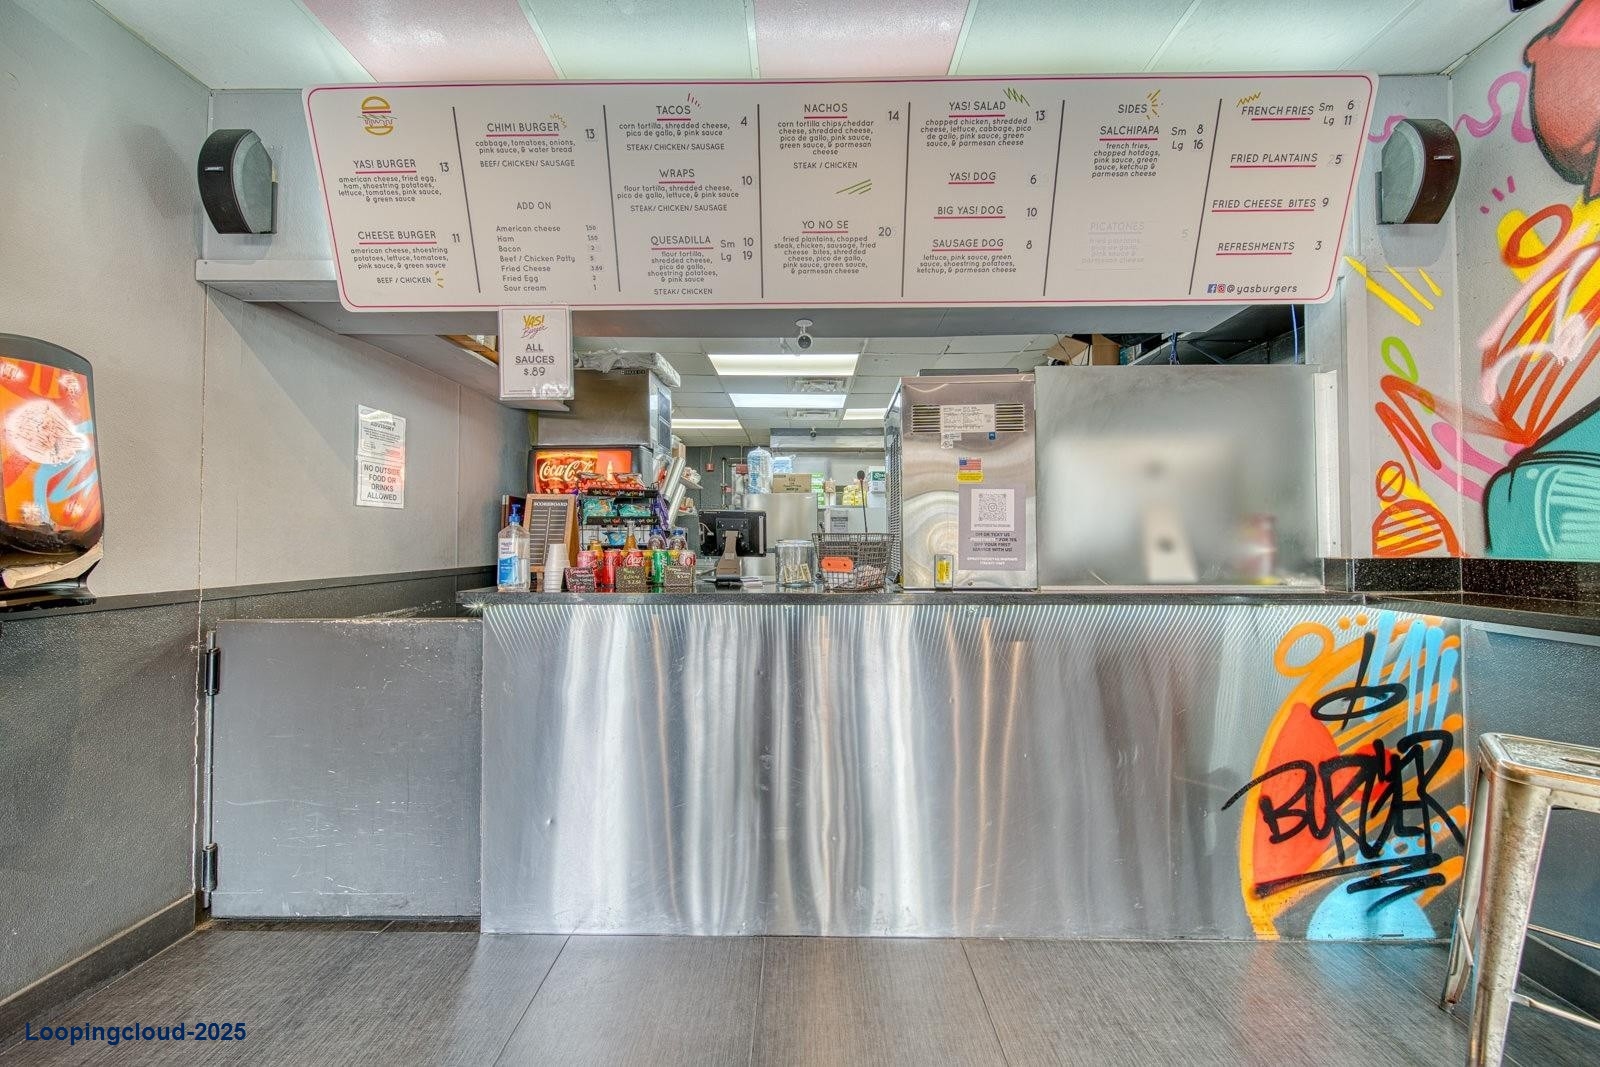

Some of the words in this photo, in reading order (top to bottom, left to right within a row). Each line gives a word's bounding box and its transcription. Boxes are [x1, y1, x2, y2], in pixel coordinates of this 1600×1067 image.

[656, 105, 691, 115] TACOS
[804, 103, 848, 112] NACHOS
[949, 101, 970, 111] YAS!
[973, 101, 1006, 110] SALAD
[1118, 104, 1147, 113] SIDES
[1242, 106, 1283, 115] FRENCH
[1286, 106, 1314, 115] FRIES
[1319, 102, 1334, 112] Sm
[1347, 100, 1354, 110] 6
[888, 111, 899, 121] 14
[1036, 110, 1045, 121] 13
[740, 116, 747, 126] 4
[1324, 116, 1334, 126] Lg
[1345, 115, 1352, 125] 11
[487, 123, 516, 132] CHIMI
[519, 122, 560, 132] BURGER
[1100, 126, 1159, 135] SALCHIPAPA
[1171, 127, 1186, 136] Sm
[1197, 124, 1203, 134] 8
[585, 129, 595, 139] 13
[1172, 141, 1183, 151] Lg
[1194, 139, 1203, 149] 16
[1231, 154, 1259, 163] FRIED
[1262, 154, 1318, 162] PLANTAINS
[1335, 154, 1342, 164] 5
[353, 160, 374, 168] YAS!
[376, 159, 416, 168] BURGER
[439, 162, 449, 172] 13
[659, 169, 695, 178] WRAPS
[950, 172, 970, 181] YAS!
[973, 172, 996, 181] DOG
[742, 176, 752, 185] 10
[1030, 175, 1037, 184] 6
[517, 202, 534, 210] ADD
[538, 202, 551, 210] ON
[1212, 200, 1240, 208] FRIED
[1244, 199, 1283, 208] CHEESE
[1288, 199, 1316, 208] BITES
[1322, 197, 1329, 207] 9
[938, 206, 953, 215] BIG
[957, 206, 978, 214] YAS!
[981, 206, 1003, 214] DOG
[1026, 207, 1037, 217] 10
[802, 221, 815, 229] YO
[819, 220, 833, 229] NO
[837, 220, 848, 229] SE
[358, 231, 395, 240] CHEESE
[397, 230, 436, 239] BURGER
[878, 227, 891, 237] 20
[452, 233, 460, 243] 11
[651, 236, 711, 246] QUESADILLA
[720, 240, 735, 248] Sm
[743, 237, 754, 246] 10
[933, 239, 978, 247] SAUSAGE
[982, 239, 1003, 247] DOG
[1026, 240, 1032, 249] 8
[1218, 242, 1295, 251] REFRESHMENTS
[1315, 241, 1322, 250] 3
[556, 255, 575, 263] Patty
[721, 253, 731, 262] Lg
[743, 251, 752, 260] 19
[524, 275, 538, 283] Egg
[1225, 284, 1297, 295] @yasburgers
[523, 314, 544, 329] YAS!
[515, 356, 555, 364] SAUCES
[523, 367, 546, 376] $.89
[375, 466, 400, 476] OUTSIDE
[369, 474, 386, 482] FOOD
[372, 483, 394, 492] DRINKS
[367, 492, 397, 501] ALLOWED
[1222, 730, 1465, 864] BURGER
